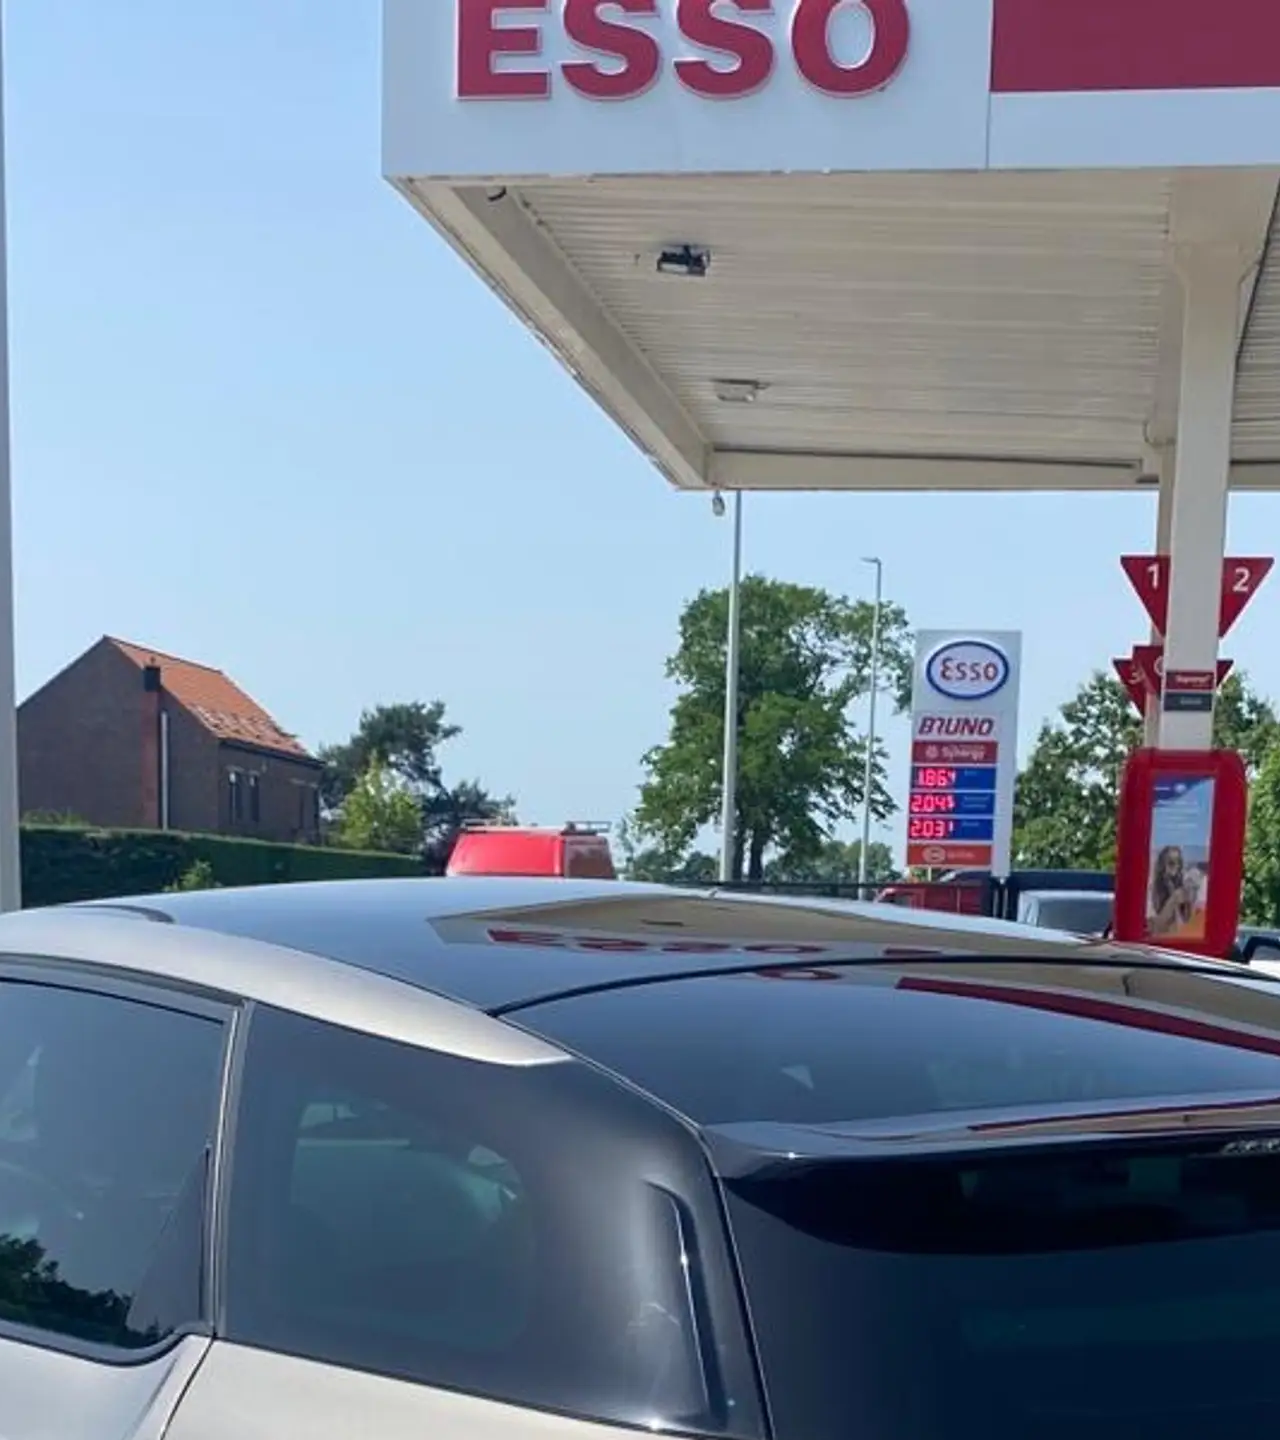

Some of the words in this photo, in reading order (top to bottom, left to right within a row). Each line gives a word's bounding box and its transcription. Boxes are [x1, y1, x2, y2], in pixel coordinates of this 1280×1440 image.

[457, 0, 911, 100] ESSO
[1147, 563, 1160, 590] 1
[1232, 566, 1251, 593] 2
